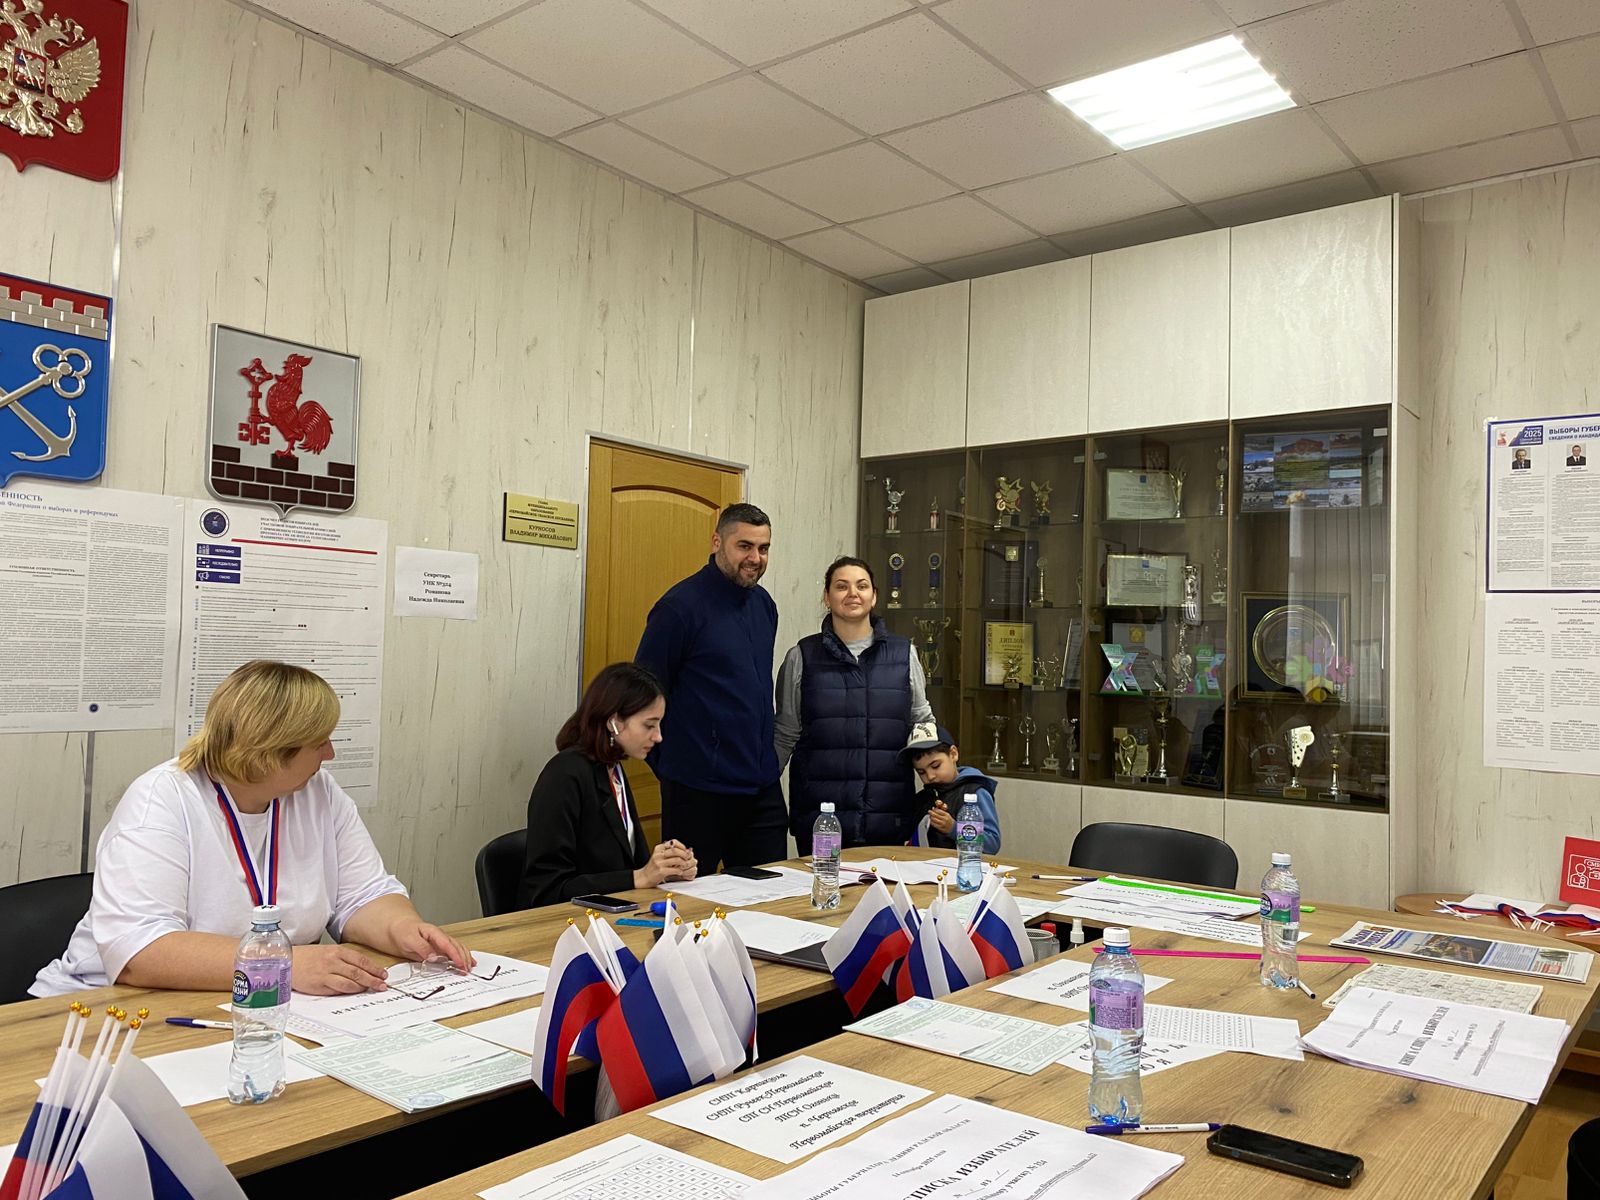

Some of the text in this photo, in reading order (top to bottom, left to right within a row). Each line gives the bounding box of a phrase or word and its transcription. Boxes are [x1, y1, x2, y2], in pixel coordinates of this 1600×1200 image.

[1523, 429, 1542, 438] 2025
[0, 490, 43, 501] ЕННОСТЬ
[510, 529, 572, 542] ВЛАДИМИР МИХАЙЛОВИЧ
[529, 525, 555, 533] КУРНОСОВ
[423, 571, 451, 579] Секретарь
[789, 1093, 906, 1150] Первомайская территория
[888, 1128, 944, 1164] ЛЕНИНГРАДСКОЙ
[942, 1118, 971, 1135] ОБЛАСТИ
[956, 1128, 1040, 1176] ИЗБИРАТЕЛЕЙ
[1005, 1170, 1032, 1190] участку
